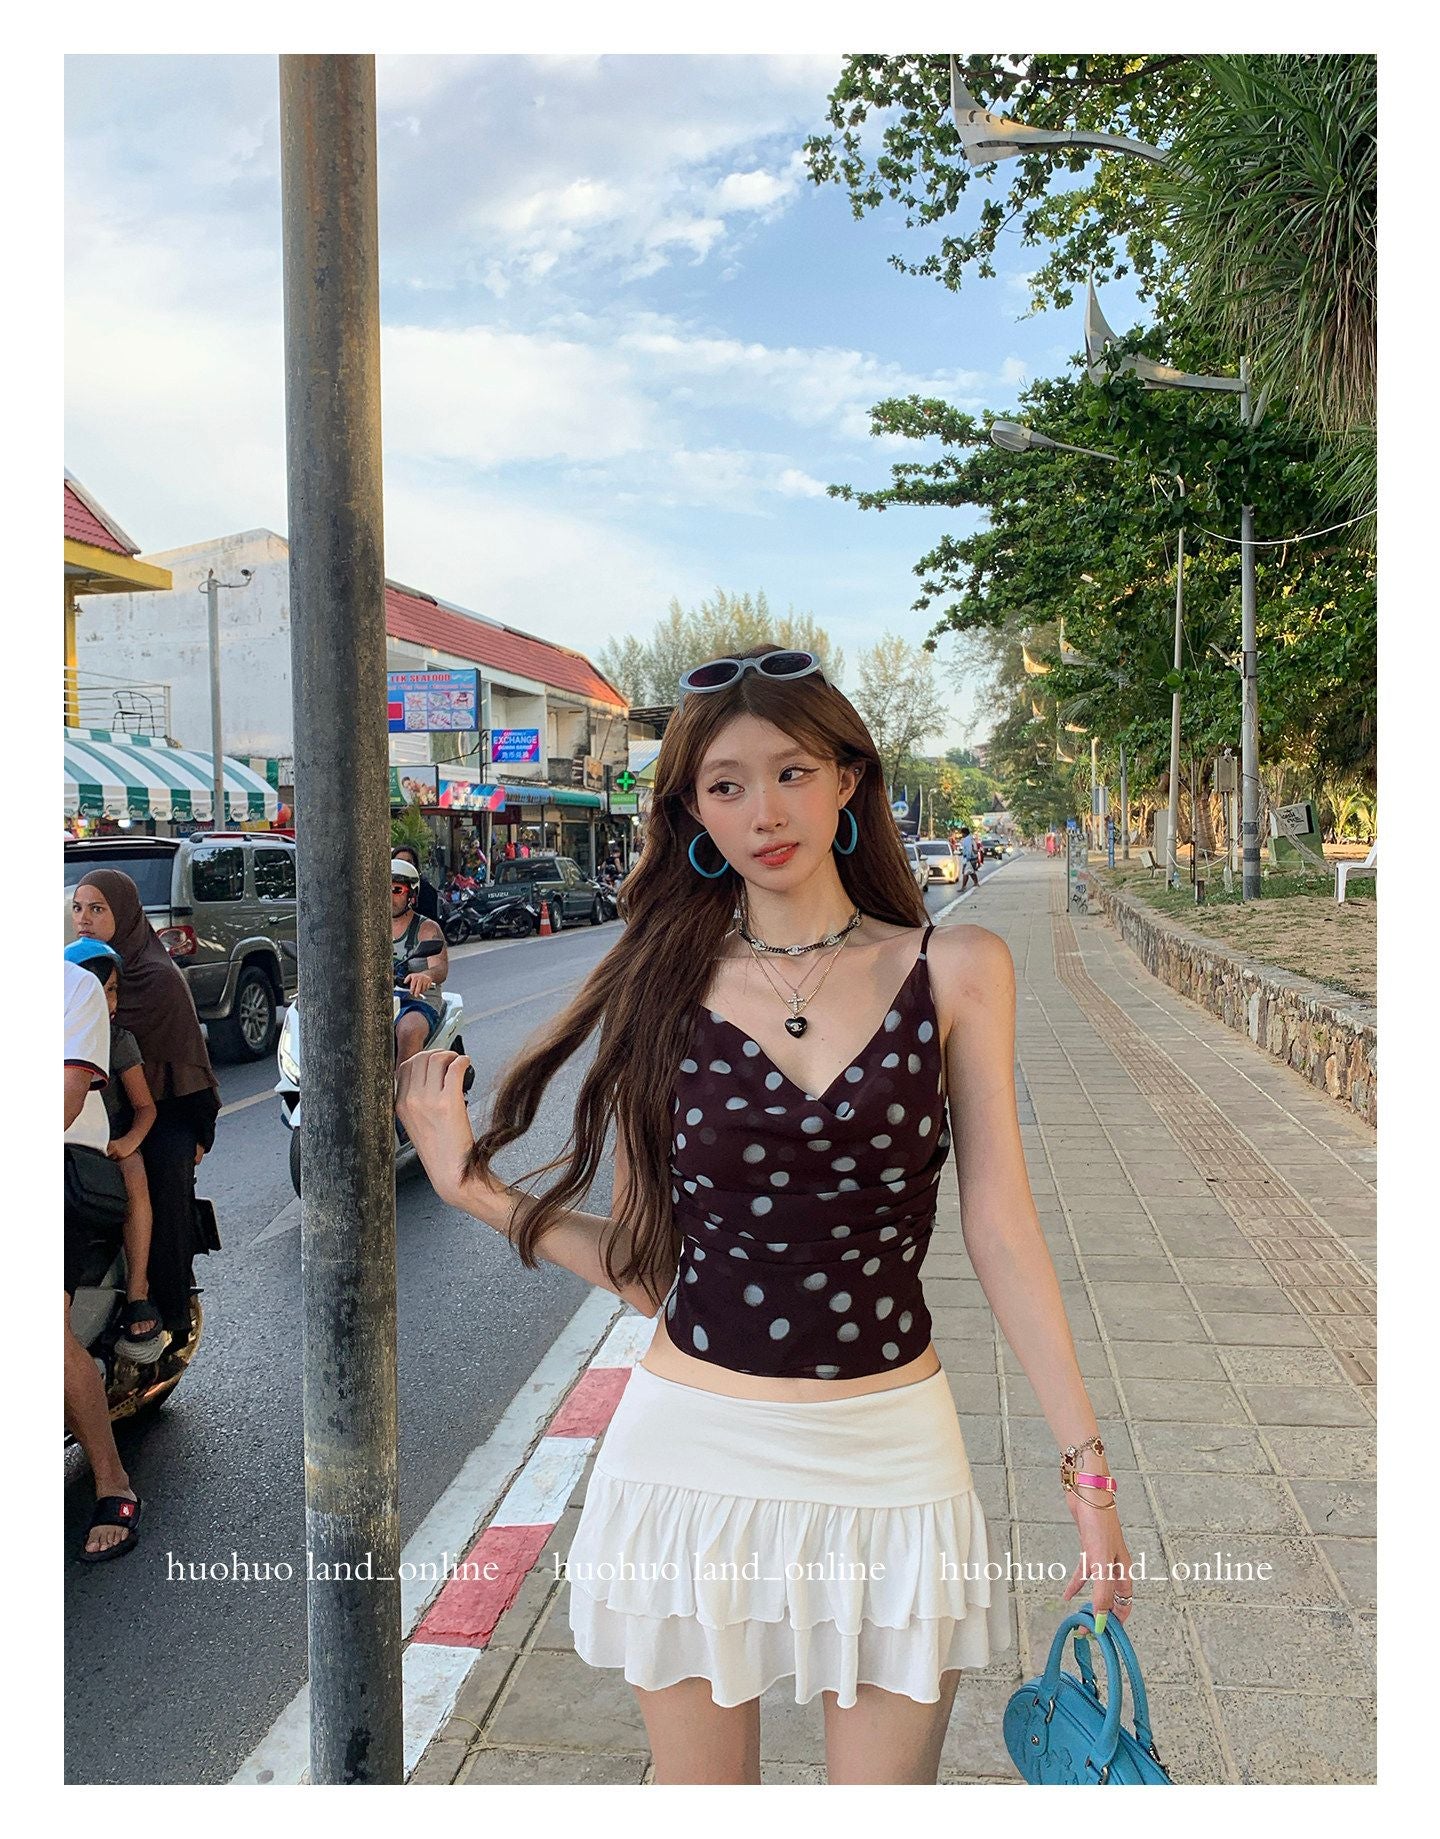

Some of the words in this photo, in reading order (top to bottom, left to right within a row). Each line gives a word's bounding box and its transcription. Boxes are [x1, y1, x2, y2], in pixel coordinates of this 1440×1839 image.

[410, 673, 451, 682] SEAFOOD
[493, 735, 537, 744] EXCHANGE
[487, 891, 509, 899] ISUZU
